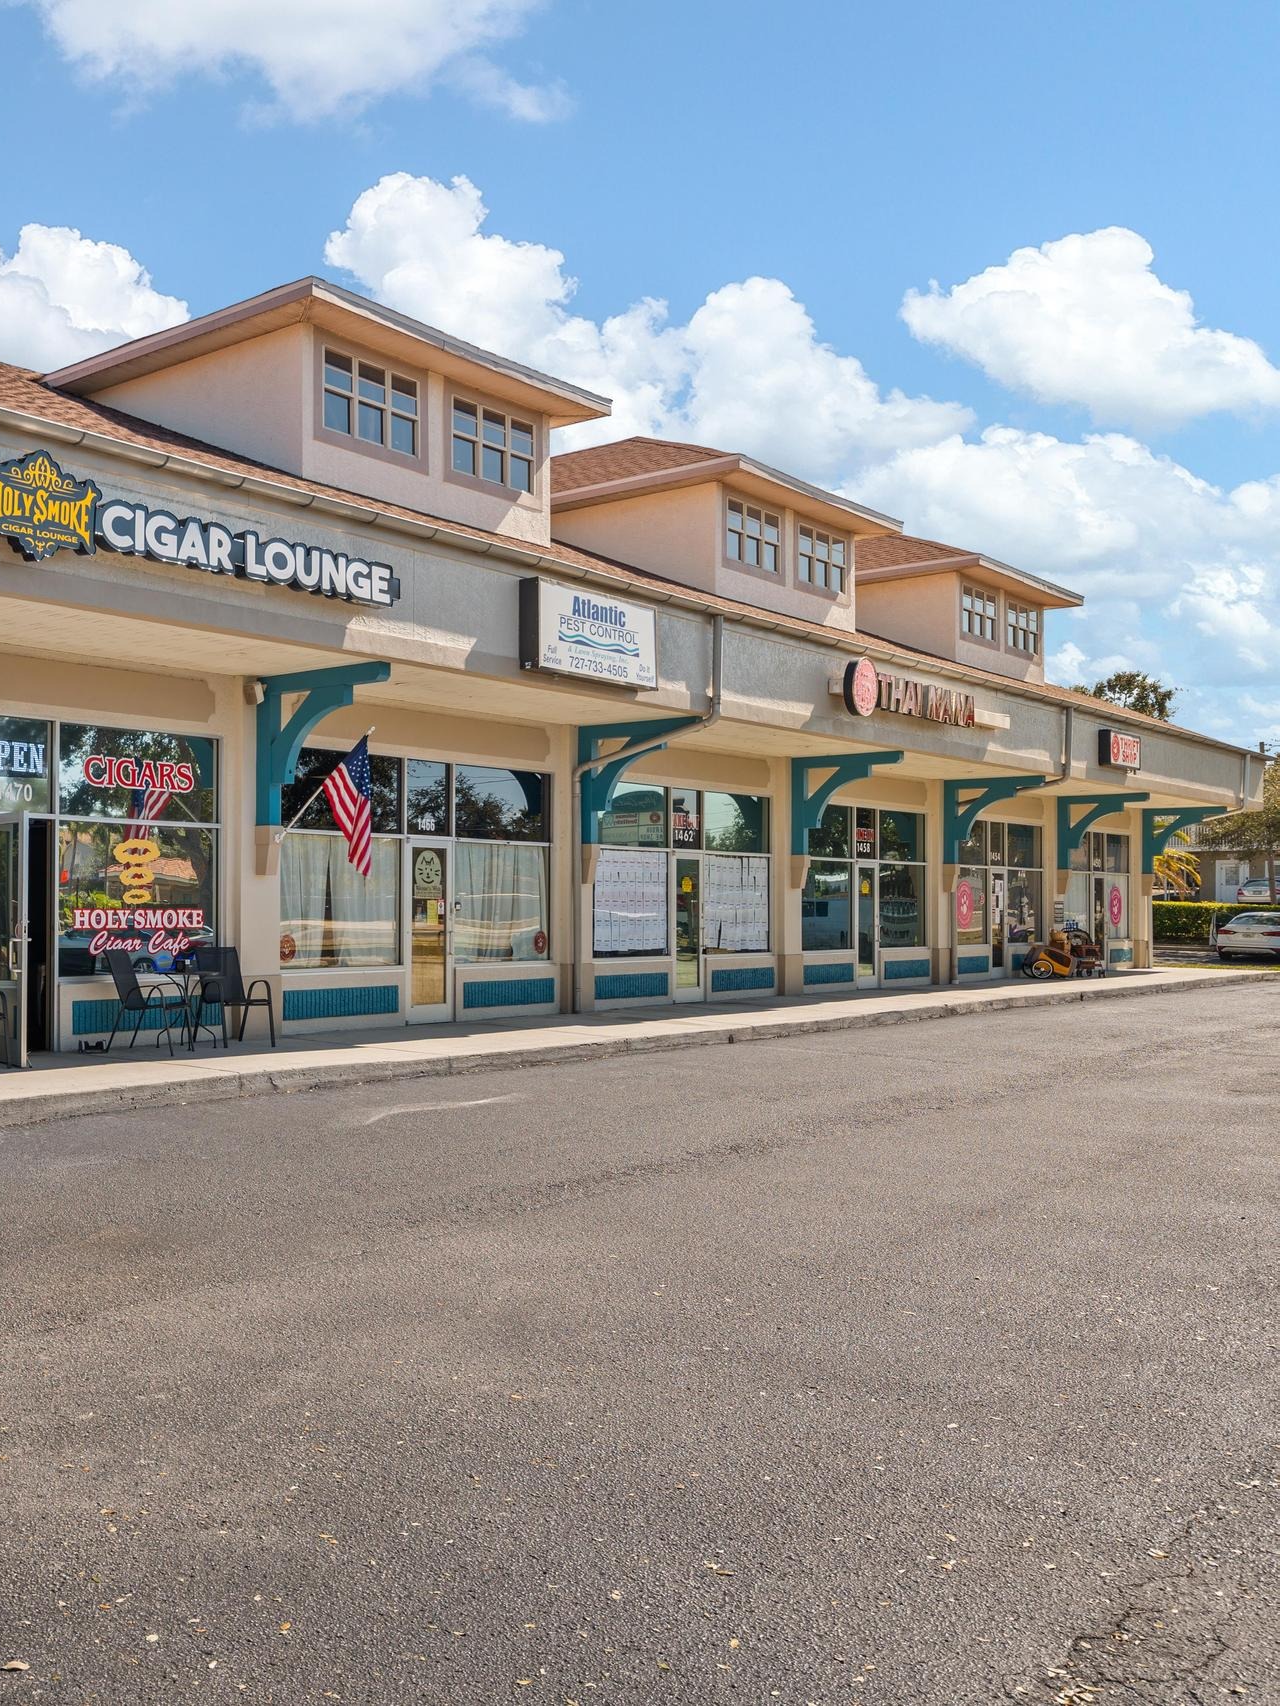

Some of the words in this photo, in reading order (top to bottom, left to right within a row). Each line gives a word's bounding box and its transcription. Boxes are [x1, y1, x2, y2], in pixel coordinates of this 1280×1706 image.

[33, 487, 96, 546] SMOKE
[1, 523, 34, 536] CIGAR
[36, 529, 79, 544] LOUNGE
[102, 505, 233, 571] CIGAR
[245, 534, 392, 604] LOUNGE
[572, 595, 626, 628] Atlantic
[560, 616, 587, 632] PEST
[589, 623, 639, 645] CONTROL
[543, 653, 562, 666] Service
[569, 655, 629, 679] 727-733-4505
[878, 672, 923, 718] THAI
[1120, 737, 1139, 753] THRIFT
[1122, 750, 1137, 765] SHOP
[83, 754, 195, 793] CIGARS
[417, 816, 435, 831] 1466
[674, 829, 694, 842] 1462
[856, 842, 871, 853] 1458
[73, 909, 131, 929] HOLY
[133, 909, 204, 929] SMOKE
[148, 930, 190, 956] Cafe
